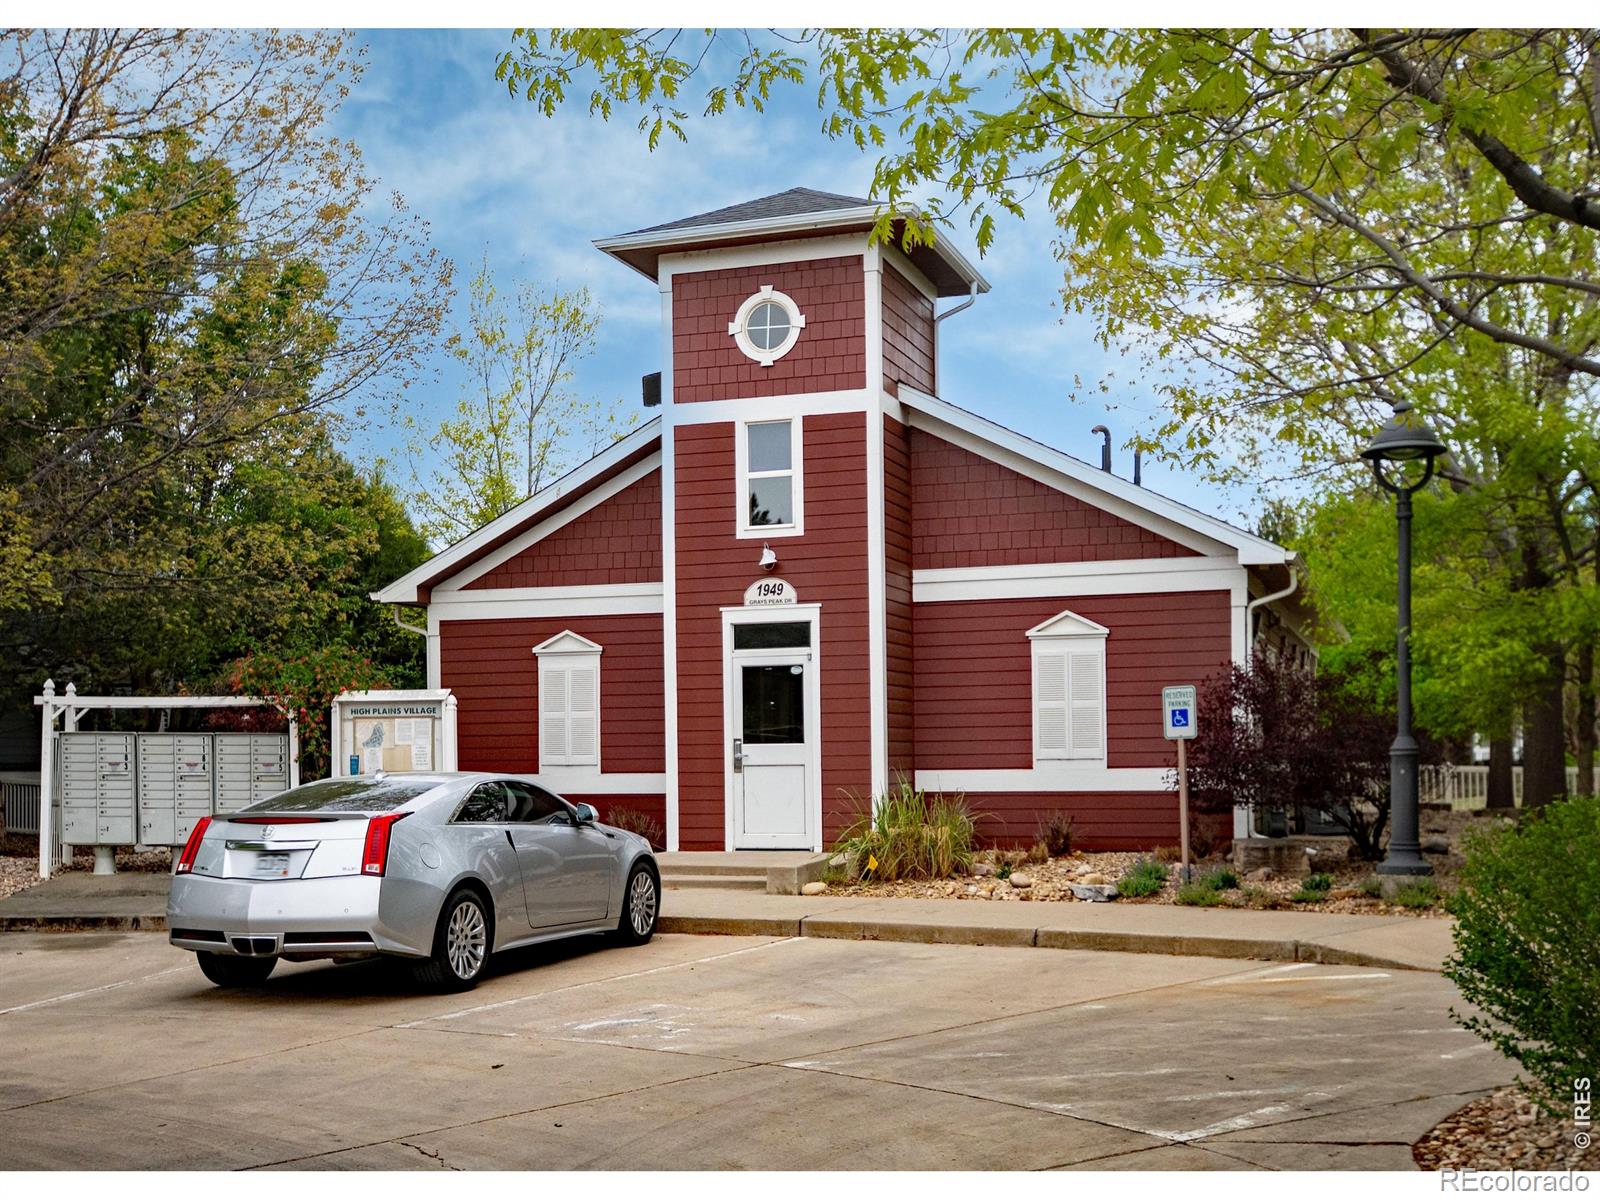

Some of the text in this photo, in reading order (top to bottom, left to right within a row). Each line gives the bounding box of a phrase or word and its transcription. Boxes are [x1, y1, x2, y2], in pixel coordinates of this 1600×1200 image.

[757, 583, 784, 596] 1949
[1165, 691, 1193, 699] RESERVED
[372, 707, 401, 715] PLAINS
